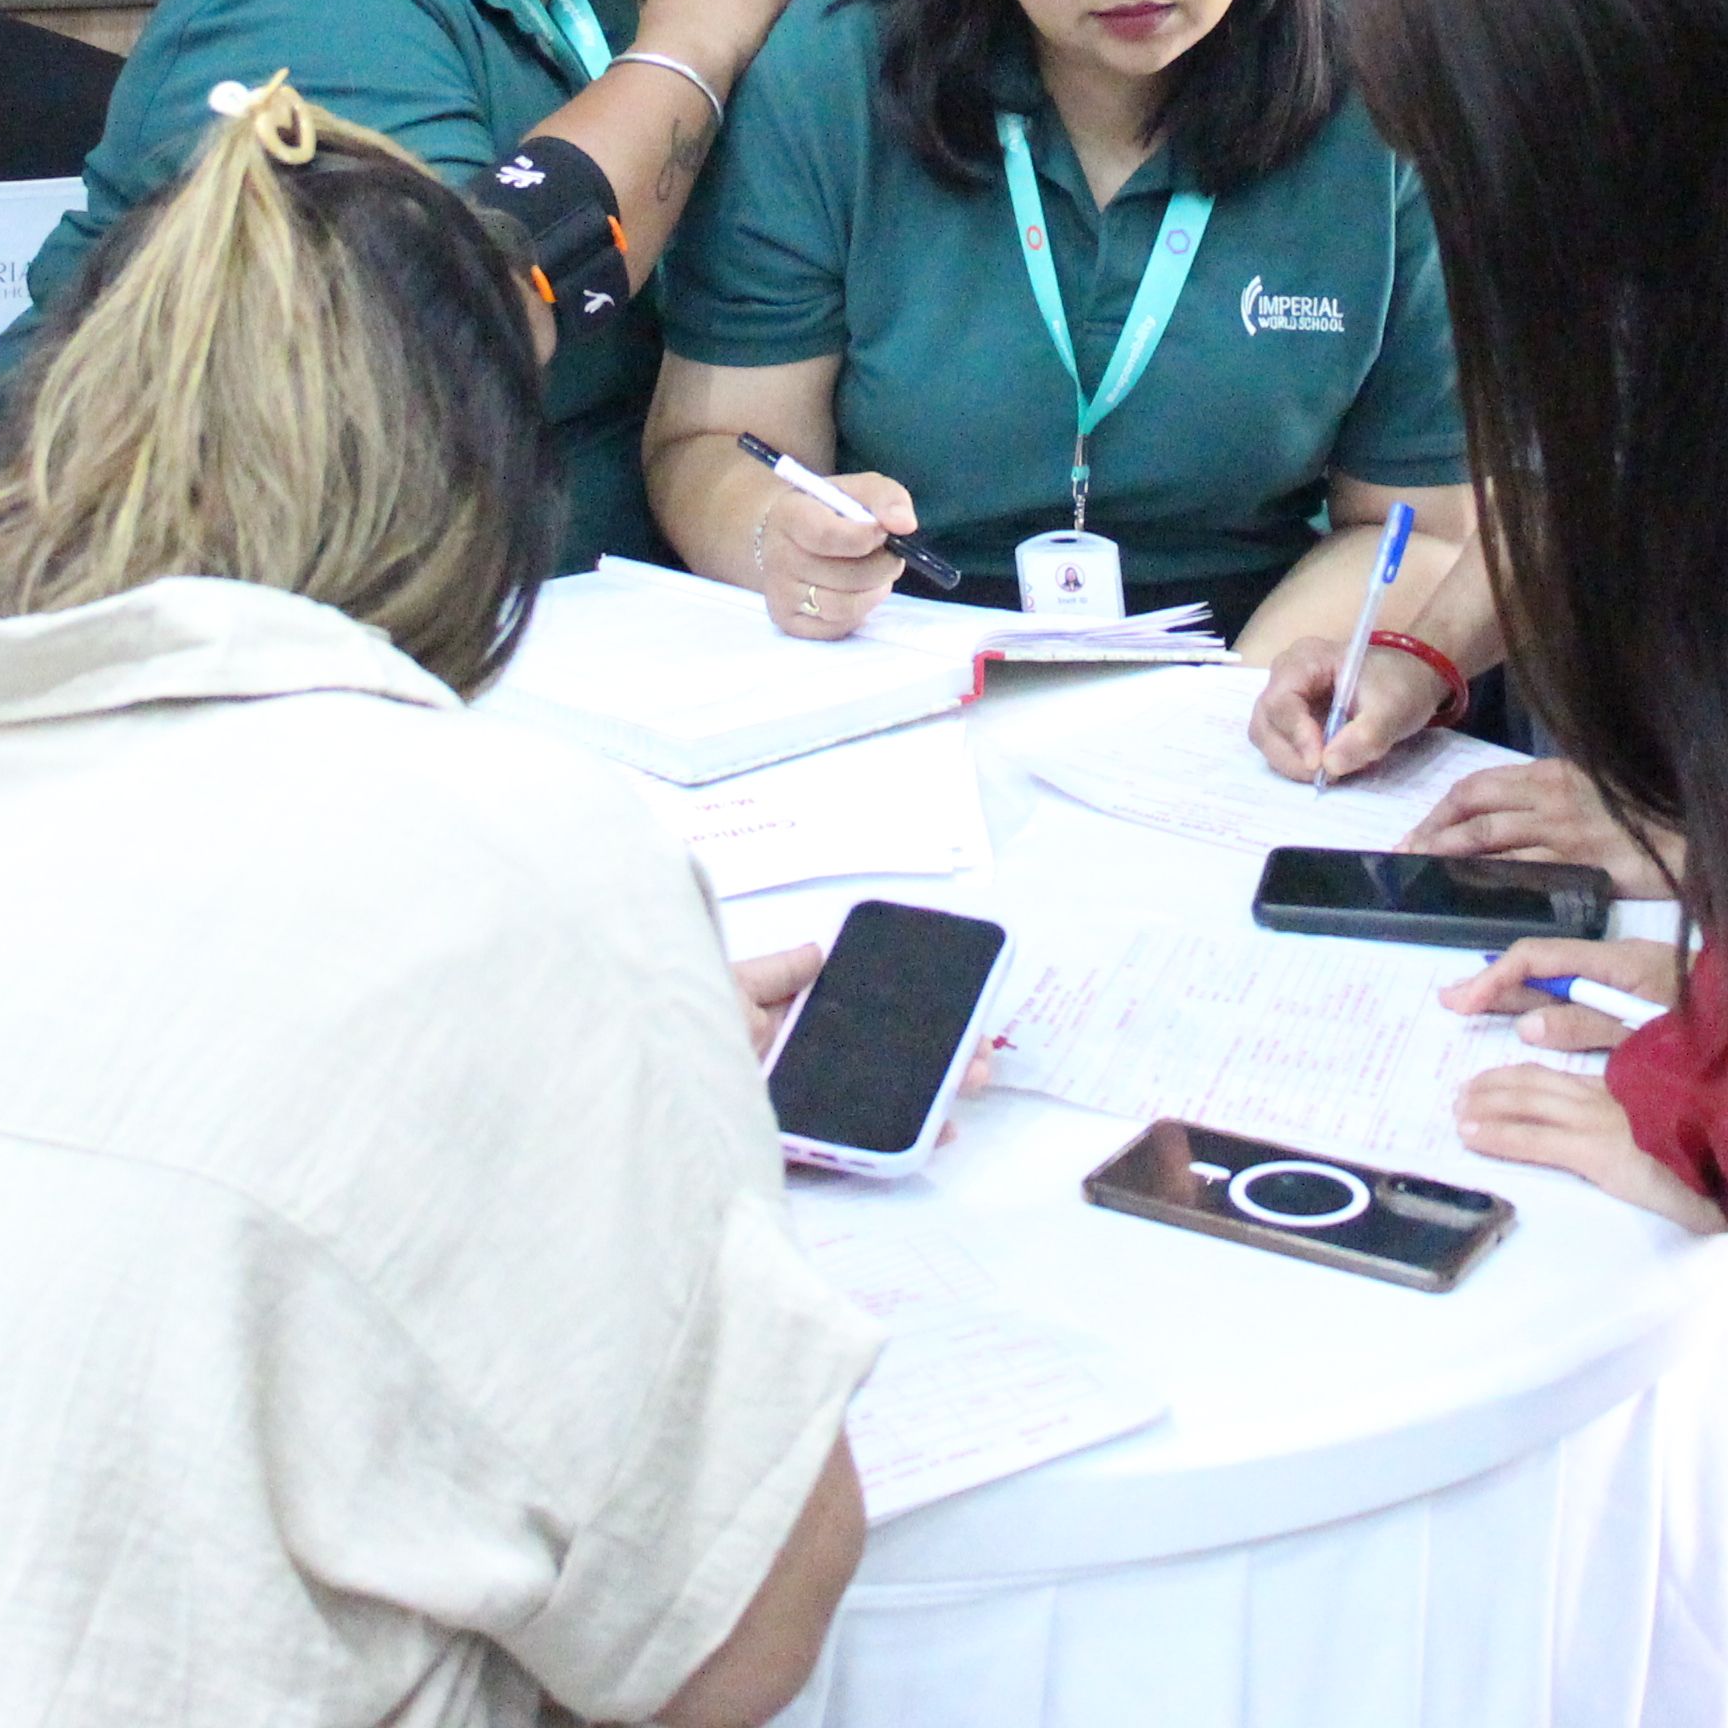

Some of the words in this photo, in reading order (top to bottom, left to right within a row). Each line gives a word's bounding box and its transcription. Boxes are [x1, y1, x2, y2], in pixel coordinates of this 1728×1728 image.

[1258, 295, 1344, 318] IMPERIAL
[1258, 316, 1297, 330] WORLD
[1298, 317, 1345, 332] SCHOOL
